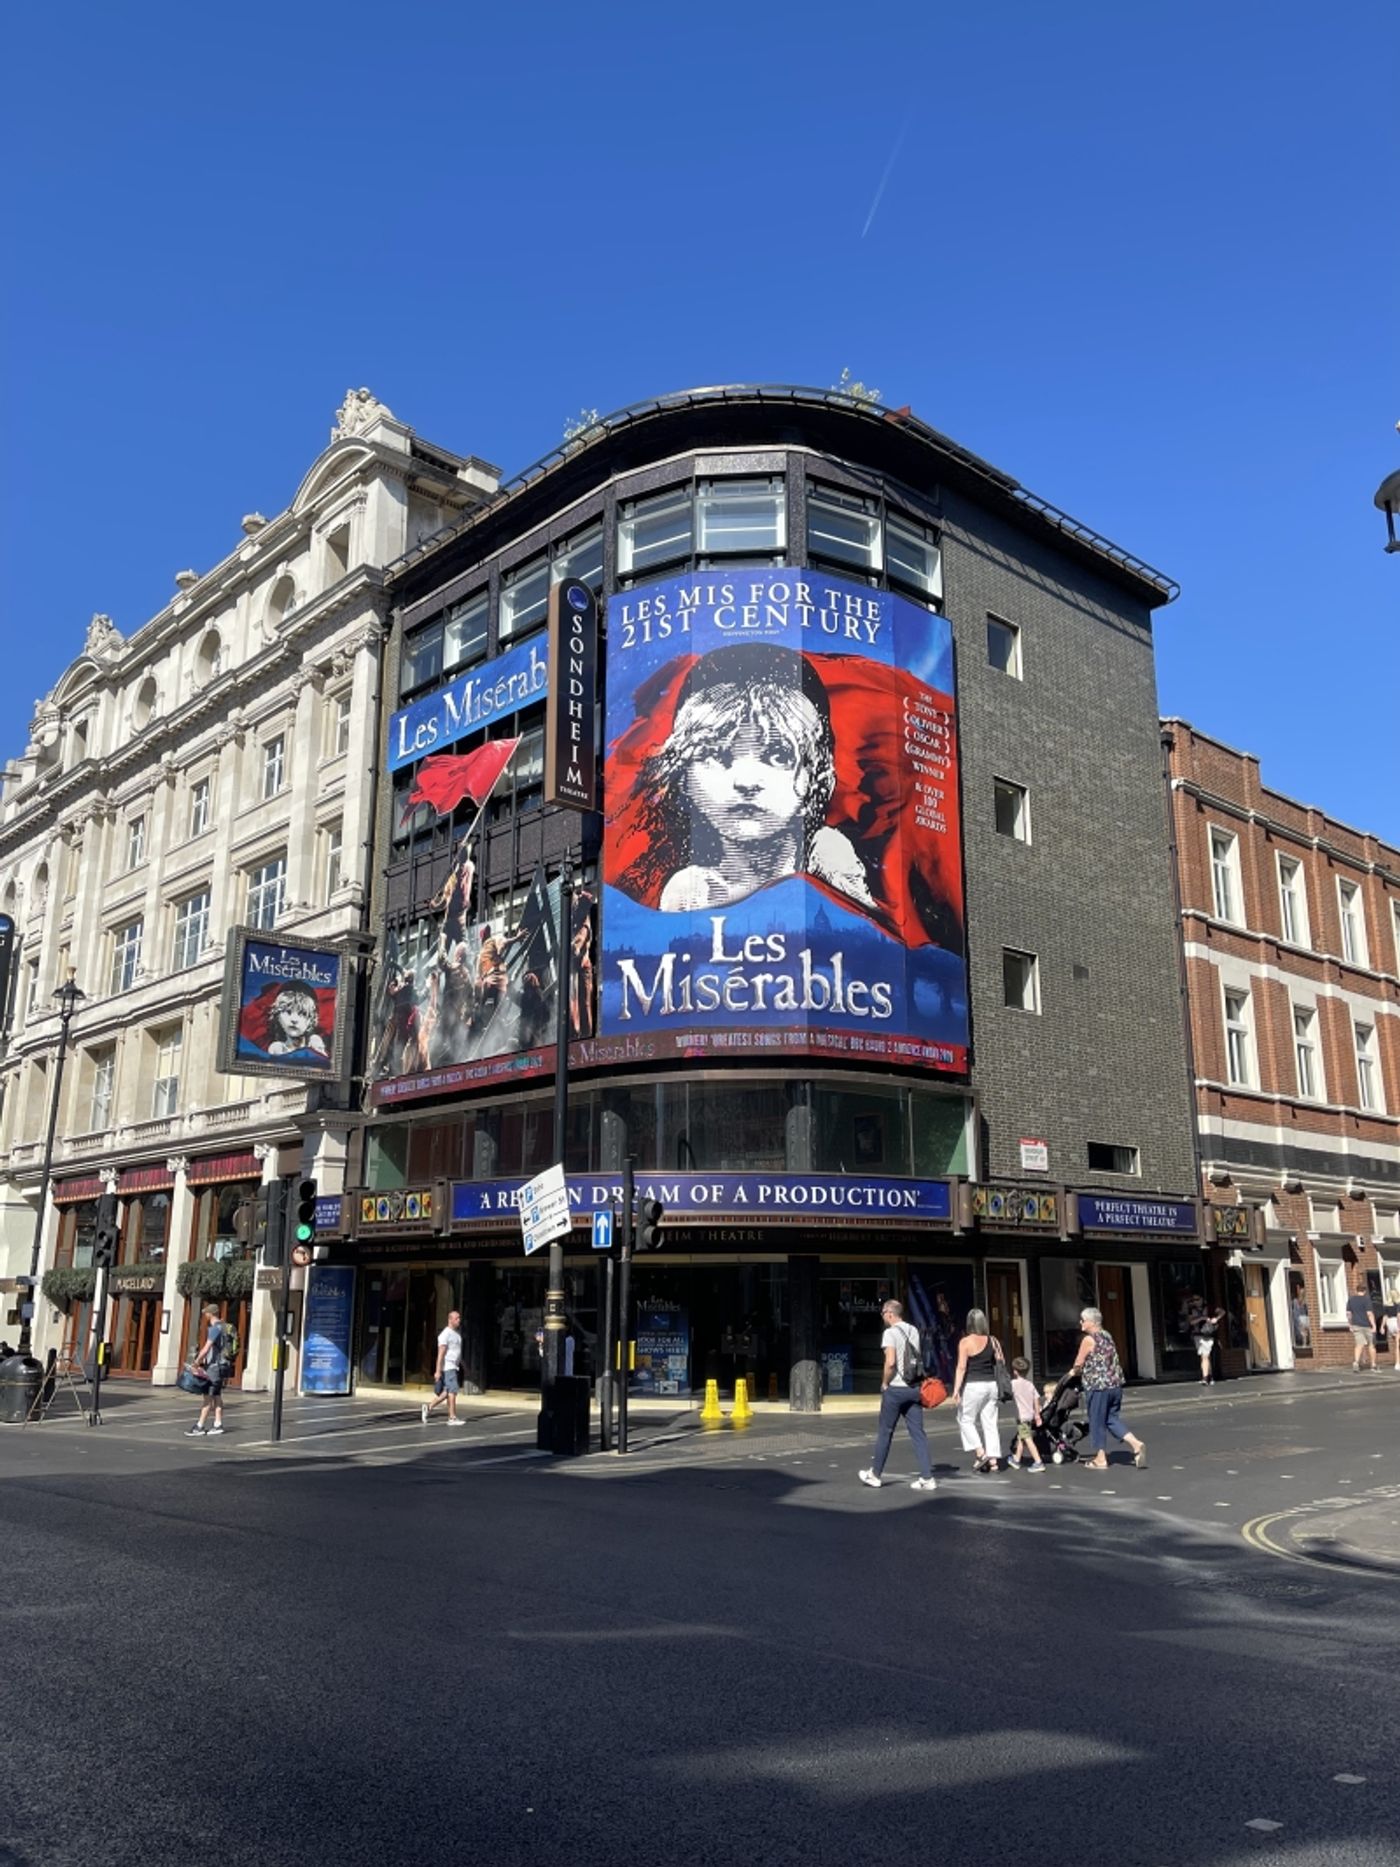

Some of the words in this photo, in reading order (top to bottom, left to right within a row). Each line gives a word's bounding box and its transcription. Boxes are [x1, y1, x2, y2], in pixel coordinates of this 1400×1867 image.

[621, 594, 666, 626] LES
[679, 584, 734, 610] MIS
[750, 582, 812, 604] FOR
[824, 588, 882, 623] THE
[621, 609, 696, 649] 21ST
[713, 602, 882, 645] CENTURY
[397, 714, 439, 760] Les
[442, 647, 549, 738] Misérab
[566, 614, 584, 787] SONDHEIM
[909, 714, 943, 735] OLIVIER
[912, 760, 945, 781] WINNER
[709, 916, 787, 964] Les
[248, 952, 333, 984] Misérables
[280, 949, 301, 966] Les
[617, 950, 893, 1020] Misérables
[497, 1186, 583, 1210] REN
[690, 1184, 724, 1204] OF
[733, 1182, 749, 1204] A
[1097, 1212, 1104, 1224] A
[1105, 1212, 1139, 1225] PERFECT
[700, 1229, 765, 1242] THEATRE
